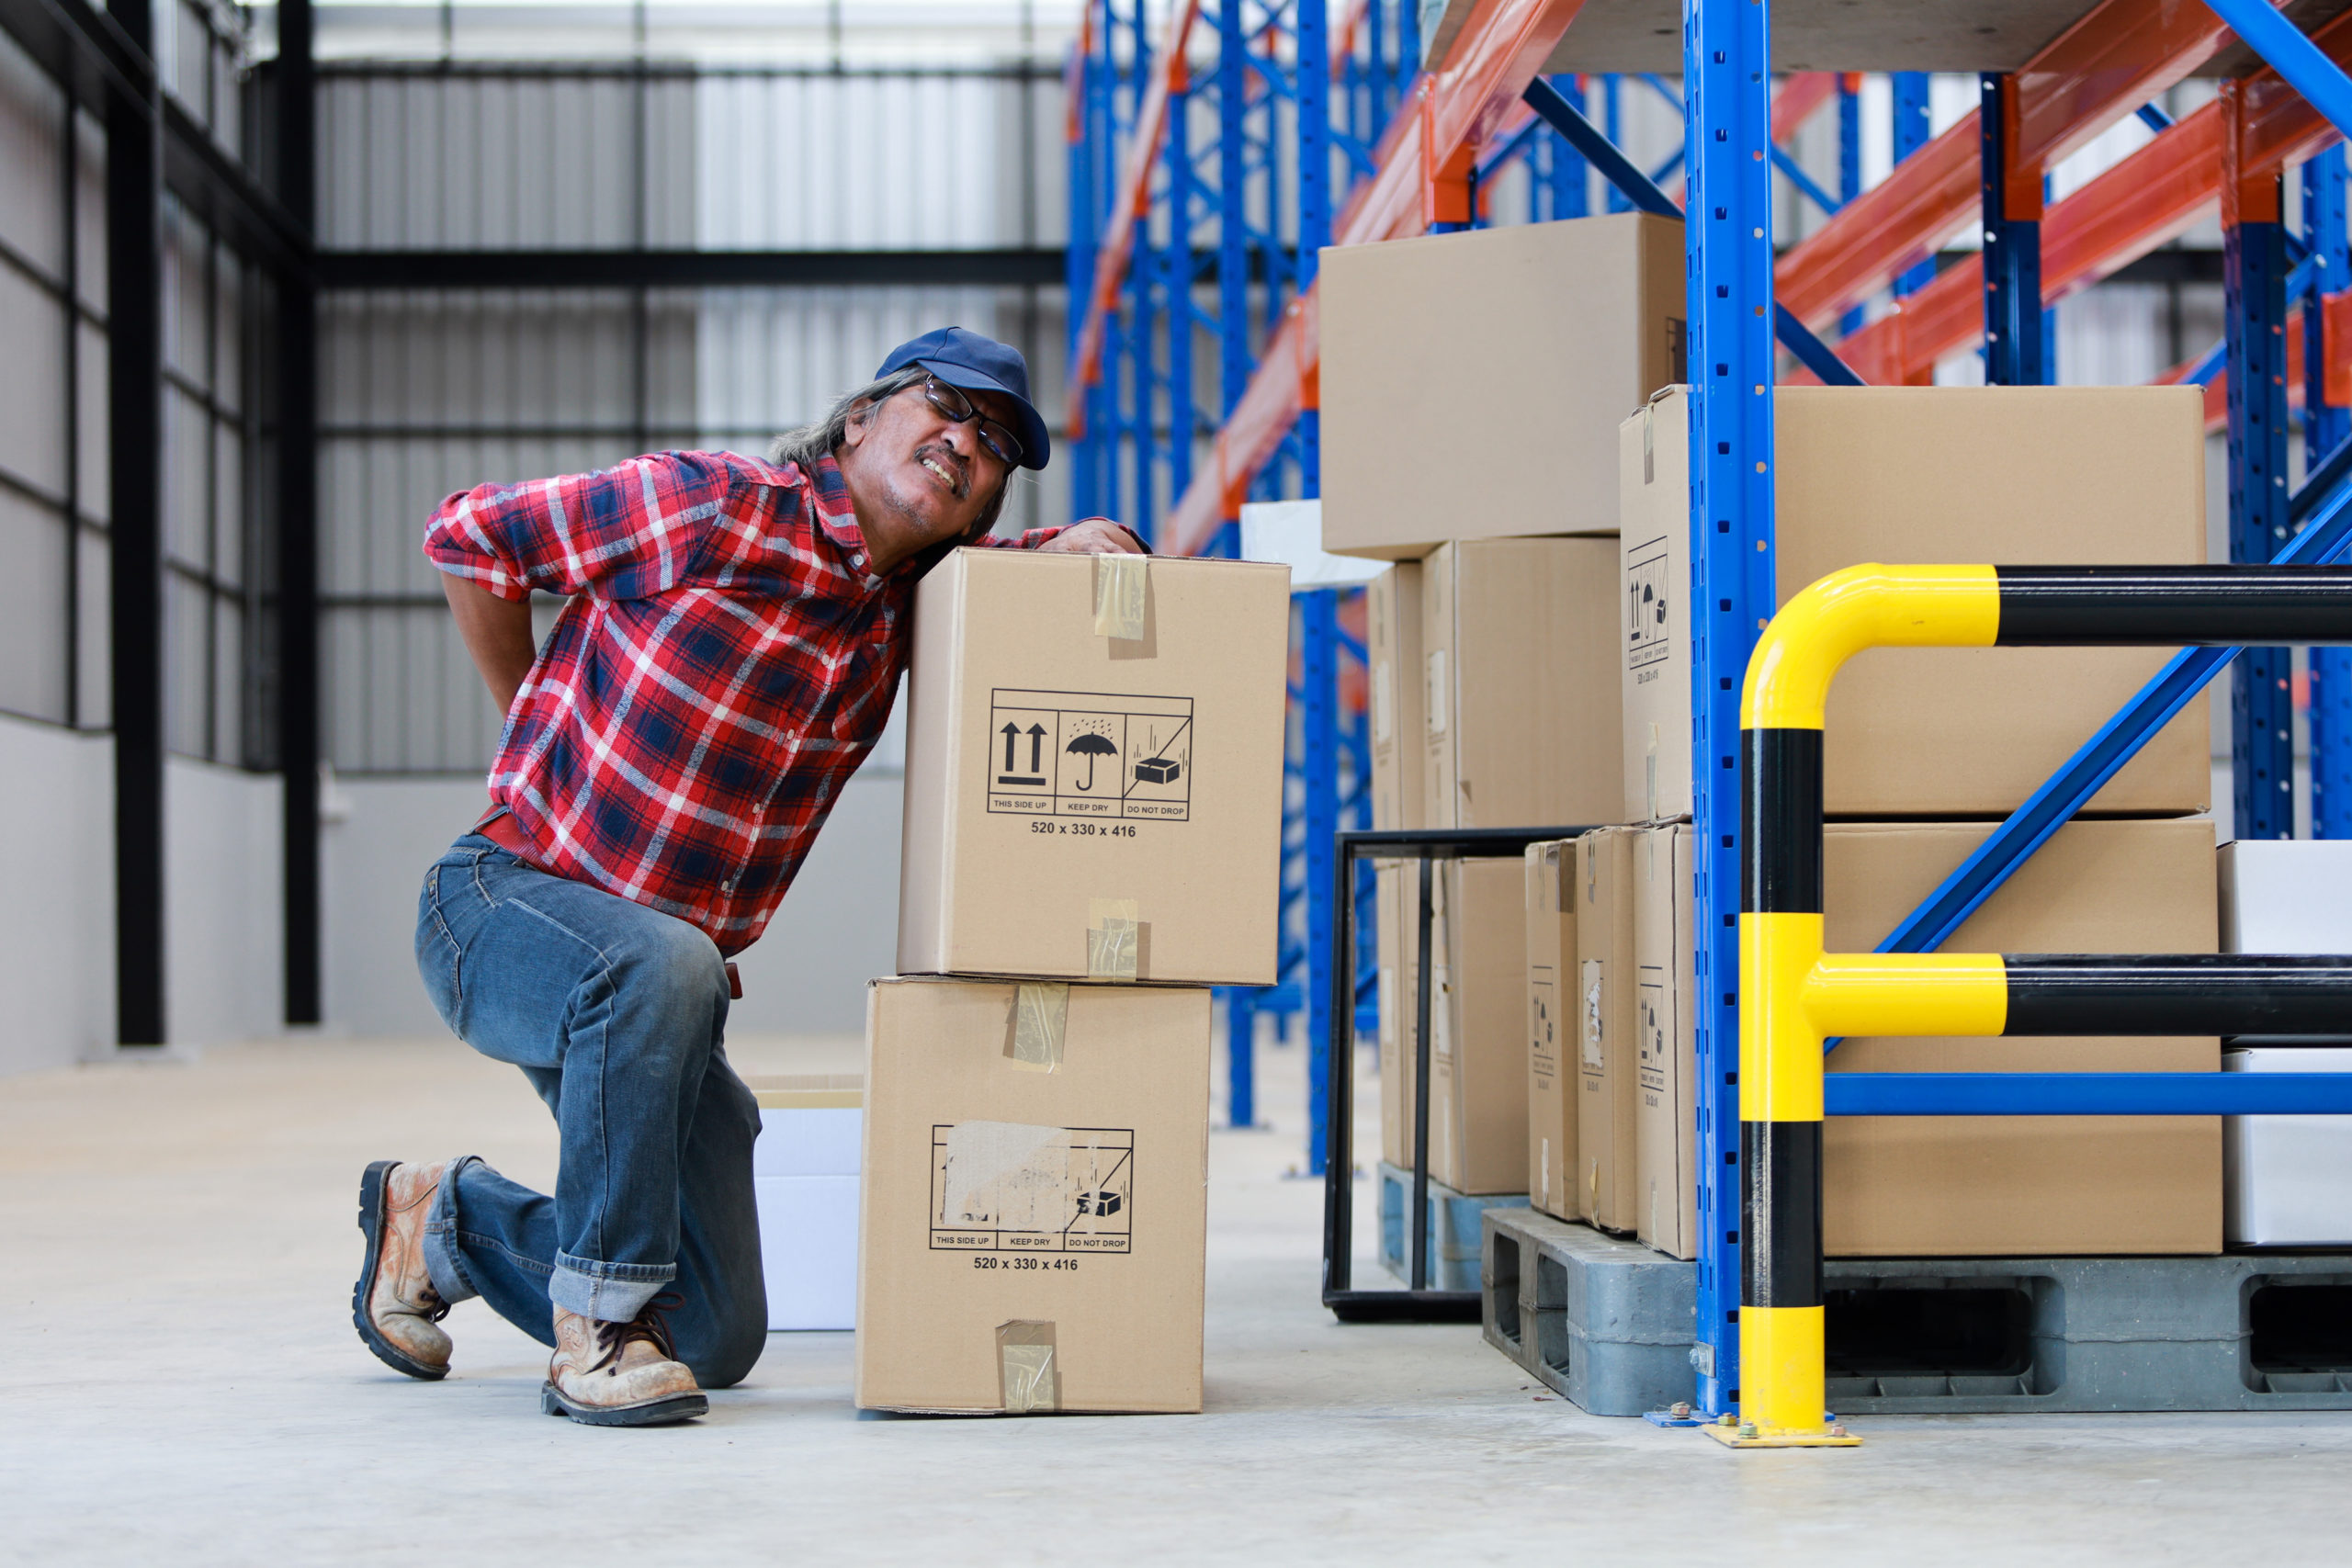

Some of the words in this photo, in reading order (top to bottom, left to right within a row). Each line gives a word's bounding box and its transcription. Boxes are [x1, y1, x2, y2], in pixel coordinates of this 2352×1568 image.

[1068, 803, 1091, 811] KEEP
[1091, 804, 1109, 812] DRY
[1127, 806, 1140, 814] DO
[1160, 807, 1184, 816] DROP
[1031, 821, 1055, 834] 520
[1071, 823, 1096, 836] 330
[1112, 825, 1136, 838] 416
[956, 1236, 976, 1245] SIDE
[1010, 1237, 1033, 1246] KEEP
[1102, 1239, 1126, 1247] DROP
[973, 1257, 998, 1269] 520
[1013, 1258, 1038, 1270] 330
[1054, 1258, 1079, 1271] 416
